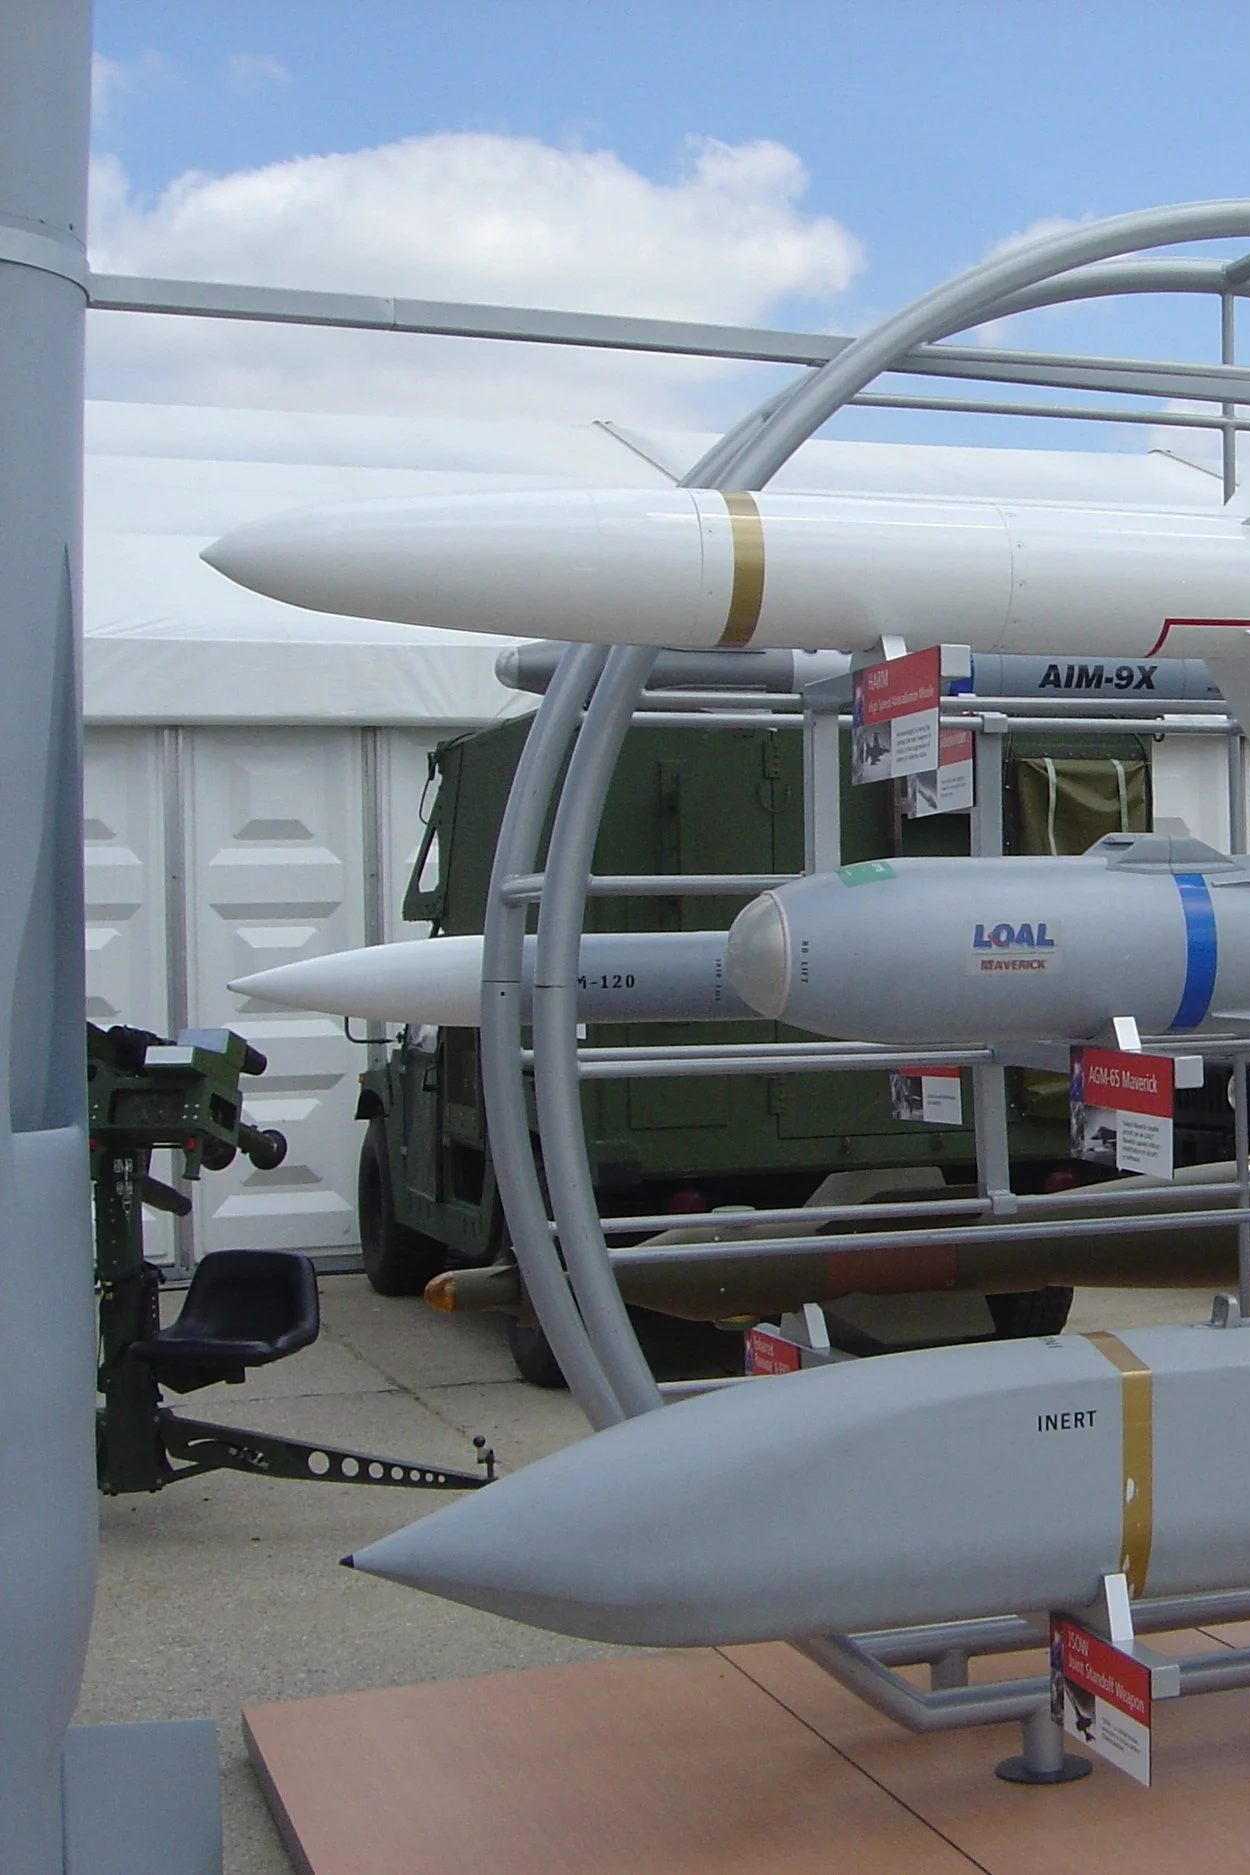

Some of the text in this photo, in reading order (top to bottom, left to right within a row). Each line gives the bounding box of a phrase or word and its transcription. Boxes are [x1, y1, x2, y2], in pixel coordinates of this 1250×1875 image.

[1038, 663, 1158, 690] AIM-9X
[973, 923, 1055, 948] LOAL
[981, 959, 1046, 971] MAVERICK
[1089, 1065, 1158, 1093] AGM-65 Maverick
[1037, 1410, 1097, 1432] INERT
[1068, 1655, 1146, 1715] Joint Standoff Weapon
